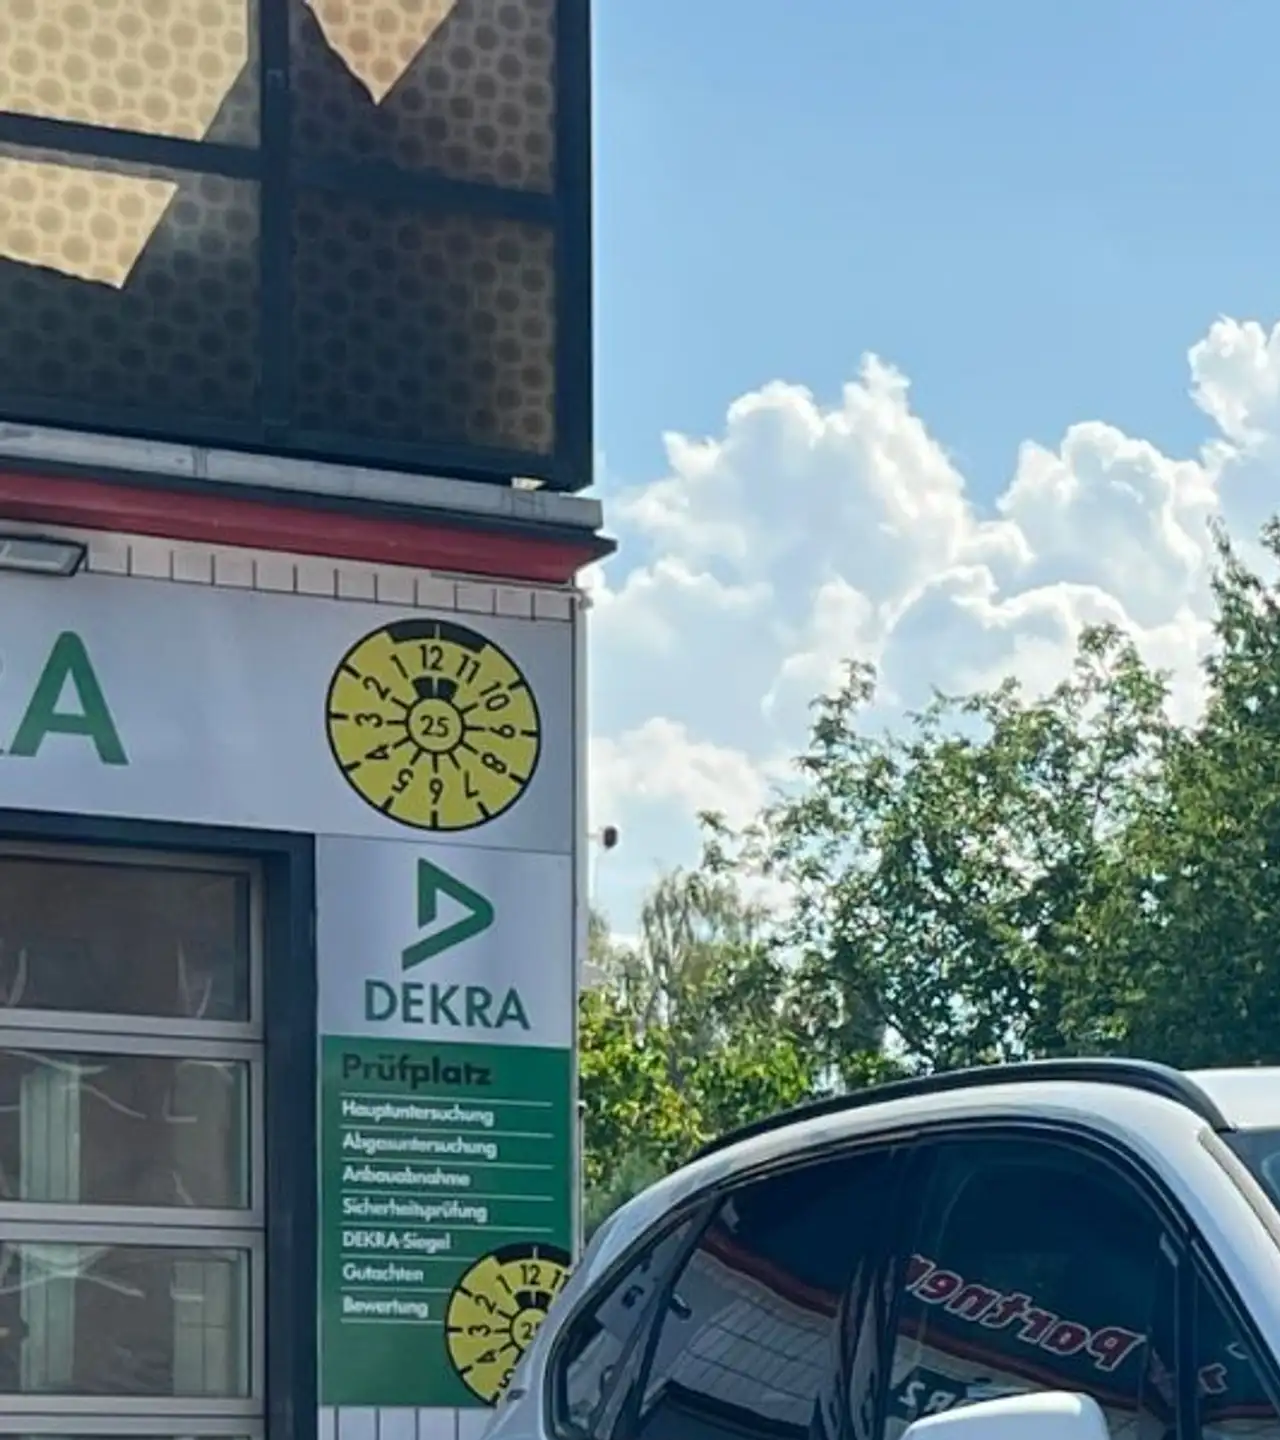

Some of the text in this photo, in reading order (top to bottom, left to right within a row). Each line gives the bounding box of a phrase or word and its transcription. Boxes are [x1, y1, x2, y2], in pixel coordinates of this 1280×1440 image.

[389, 653, 409, 680] 1
[419, 643, 444, 671] 12
[455, 652, 481, 684] 11
[0, 631, 129, 766] A
[361, 675, 392, 701] 2
[479, 681, 511, 712] 10
[354, 712, 384, 729] 3
[419, 714, 450, 738] 25
[364, 743, 390, 761] 4
[480, 752, 508, 775] 8
[391, 767, 415, 793] 5
[364, 978, 532, 1031] DEKRA
[342, 1052, 493, 1091] Prüfplatz
[341, 1099, 495, 1128] Hauptuntersuchung
[342, 1130, 498, 1160] Abgasuntersuchung
[342, 1164, 471, 1187] Anbauabnahme
[342, 1196, 488, 1223] Sicherheitsprüfung
[342, 1262, 424, 1283] Gutachten
[520, 1263, 541, 1286] 12
[342, 1295, 429, 1319] Bewertung
[474, 1294, 497, 1315] 2
[467, 1324, 492, 1338] 3
